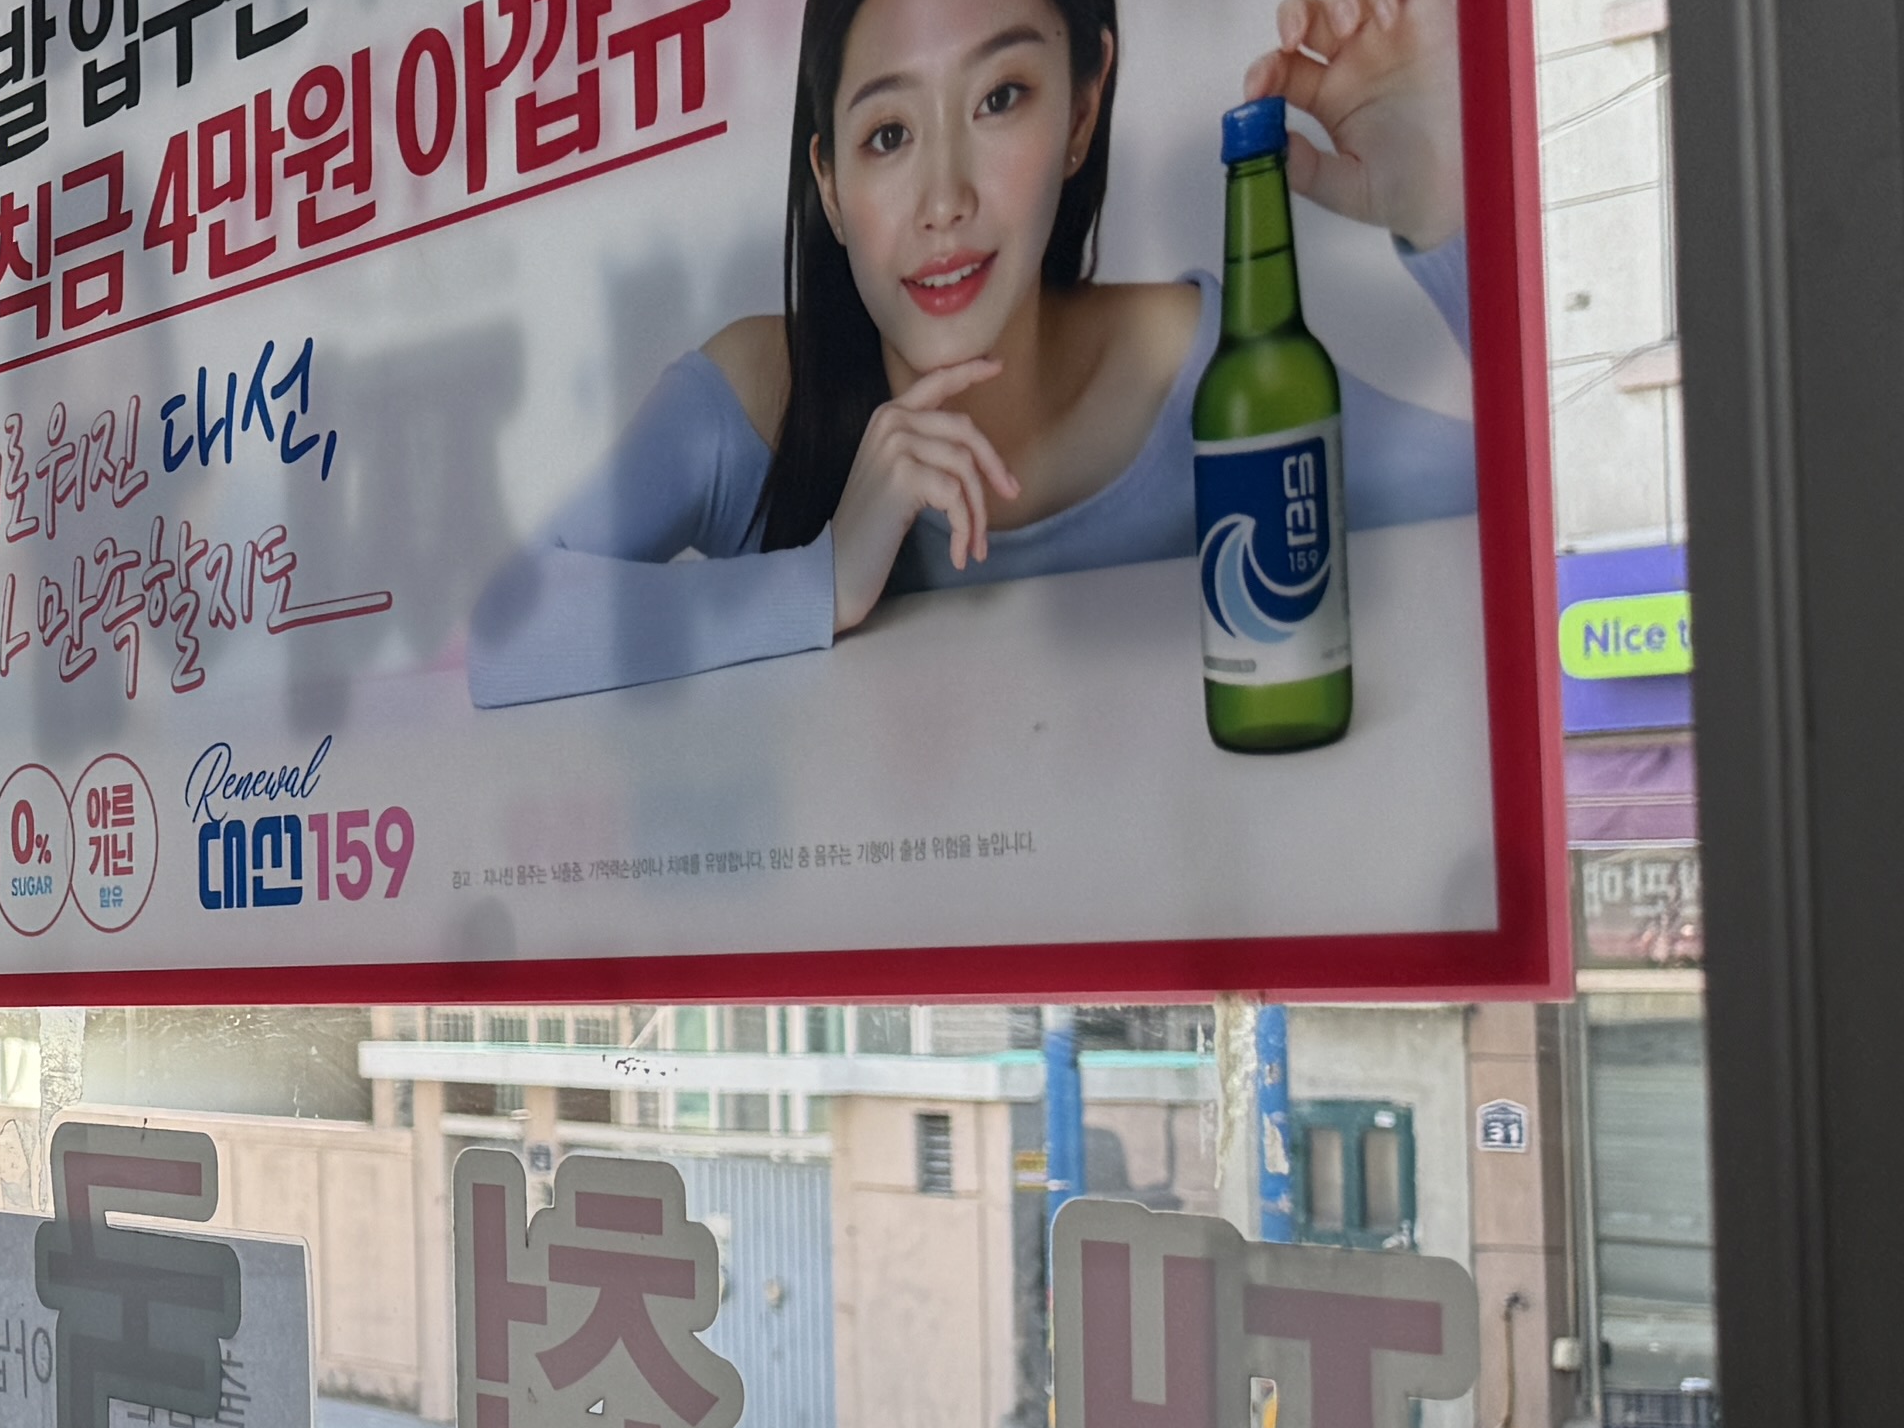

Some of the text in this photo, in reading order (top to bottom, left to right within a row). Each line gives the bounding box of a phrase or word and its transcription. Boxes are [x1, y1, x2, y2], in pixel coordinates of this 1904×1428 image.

[143, 47, 377, 282] 4만원
[160, 337, 337, 482] 대선,
[1288, 549, 1319, 572] 159
[37, 515, 392, 701] 만족할지도
[1583, 618, 1666, 657] Nice
[184, 734, 333, 823] Renewal
[86, 783, 135, 829] 아르
[11, 799, 52, 865] 0%
[88, 832, 134, 877] 기닌
[769, 847, 793, 870] 임신
[814, 843, 852, 866] 음주는
[857, 841, 894, 864] 기형아
[900, 838, 926, 861] 출생
[932, 834, 971, 861] 위험을
[11, 876, 53, 897] SUGAR
[1487, 1121, 1520, 1142] 31
